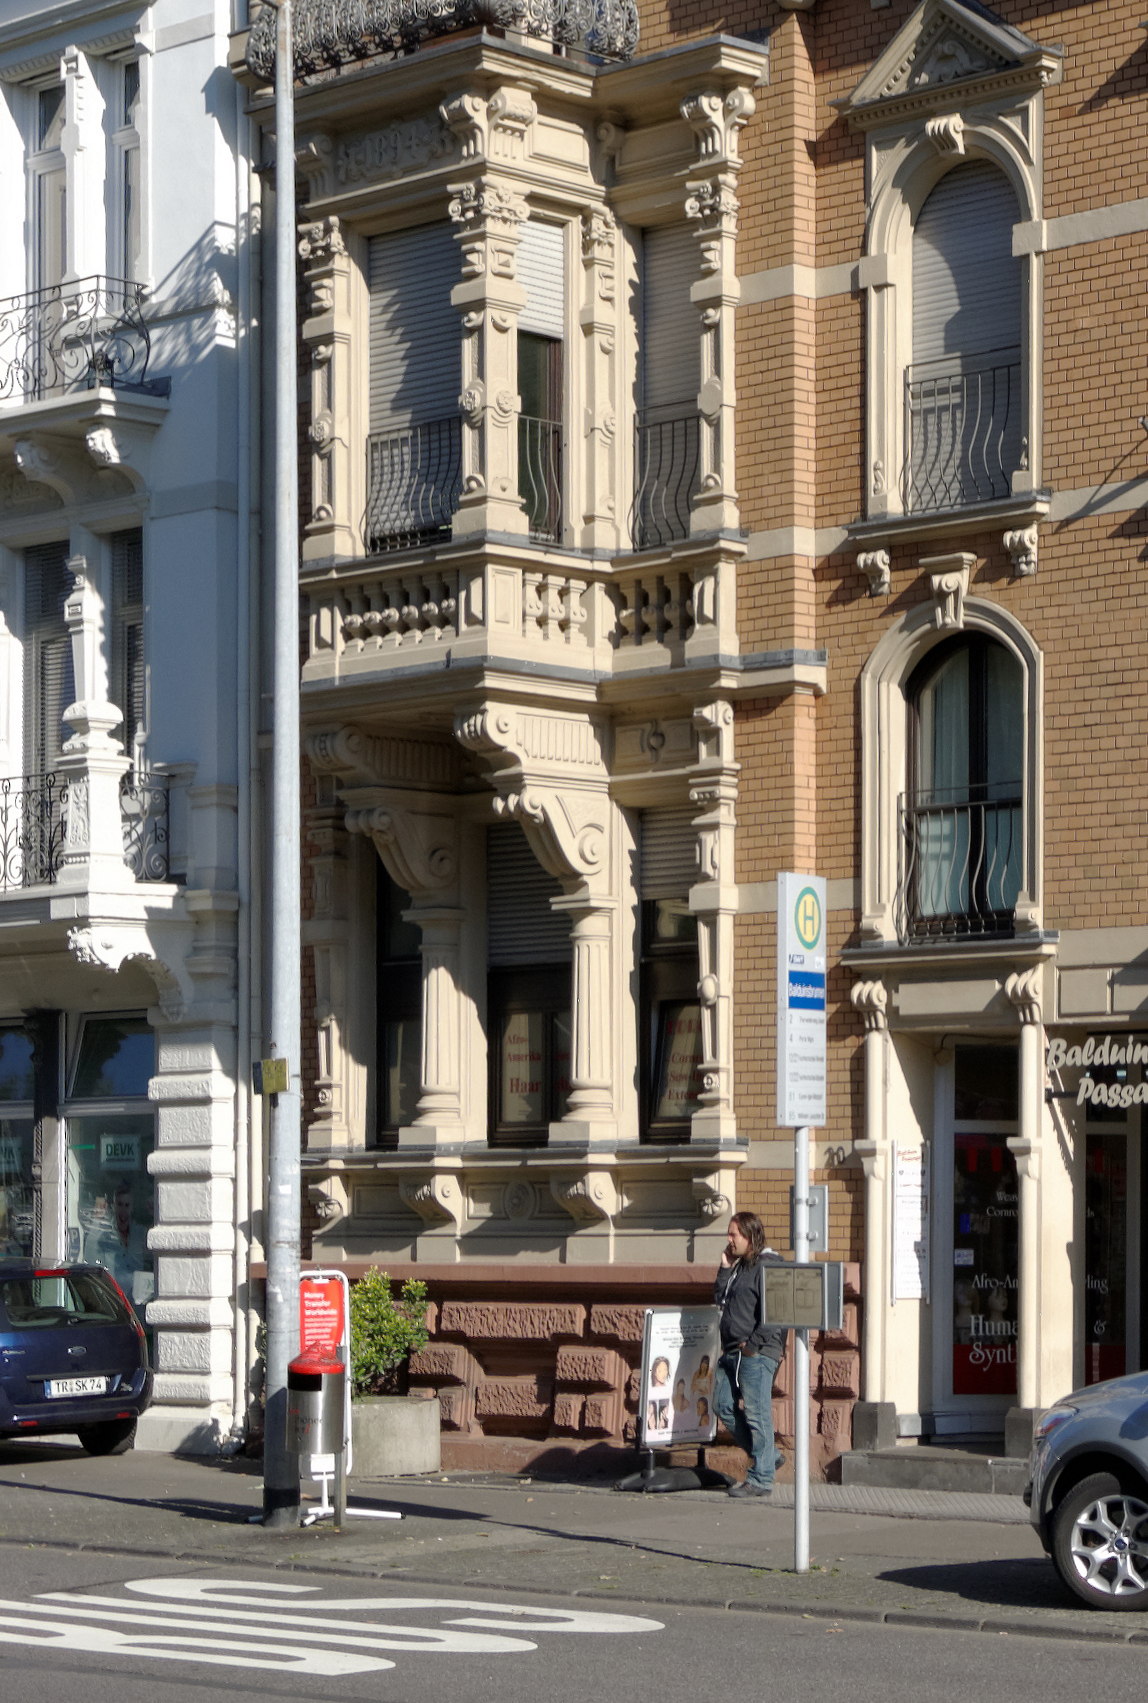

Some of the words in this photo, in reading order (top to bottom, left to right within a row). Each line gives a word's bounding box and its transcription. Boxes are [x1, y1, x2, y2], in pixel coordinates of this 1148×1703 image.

[803, 900, 815, 935] H
[106, 1143, 134, 1156] DEVK
[824, 1147, 845, 1168] 20
[55, 1380, 68, 1393] TR
[75, 1379, 88, 1392] SK
[90, 1378, 102, 1390] 74
